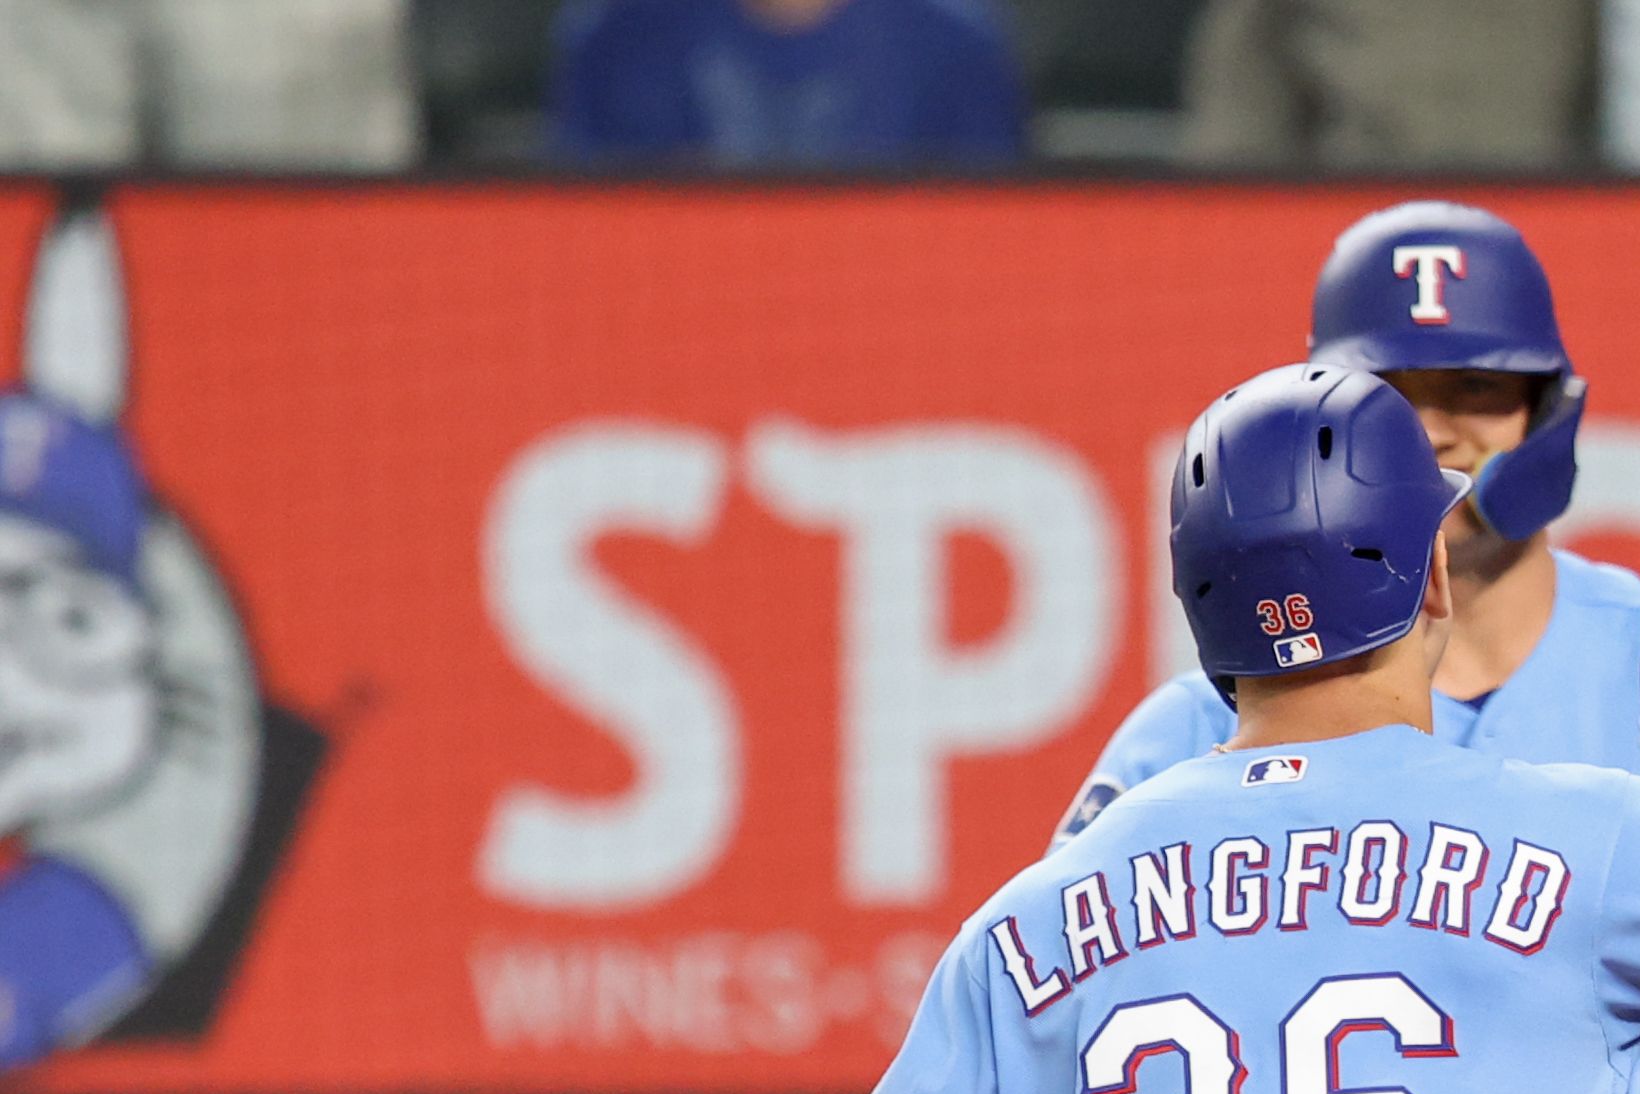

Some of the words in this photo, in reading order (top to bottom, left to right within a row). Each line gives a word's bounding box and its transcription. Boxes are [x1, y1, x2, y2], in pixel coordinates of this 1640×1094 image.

[1393, 245, 1468, 326] T
[1256, 593, 1314, 636] 36
[990, 820, 1571, 1018] LANGFORD
[468, 930, 824, 1055] WINES
